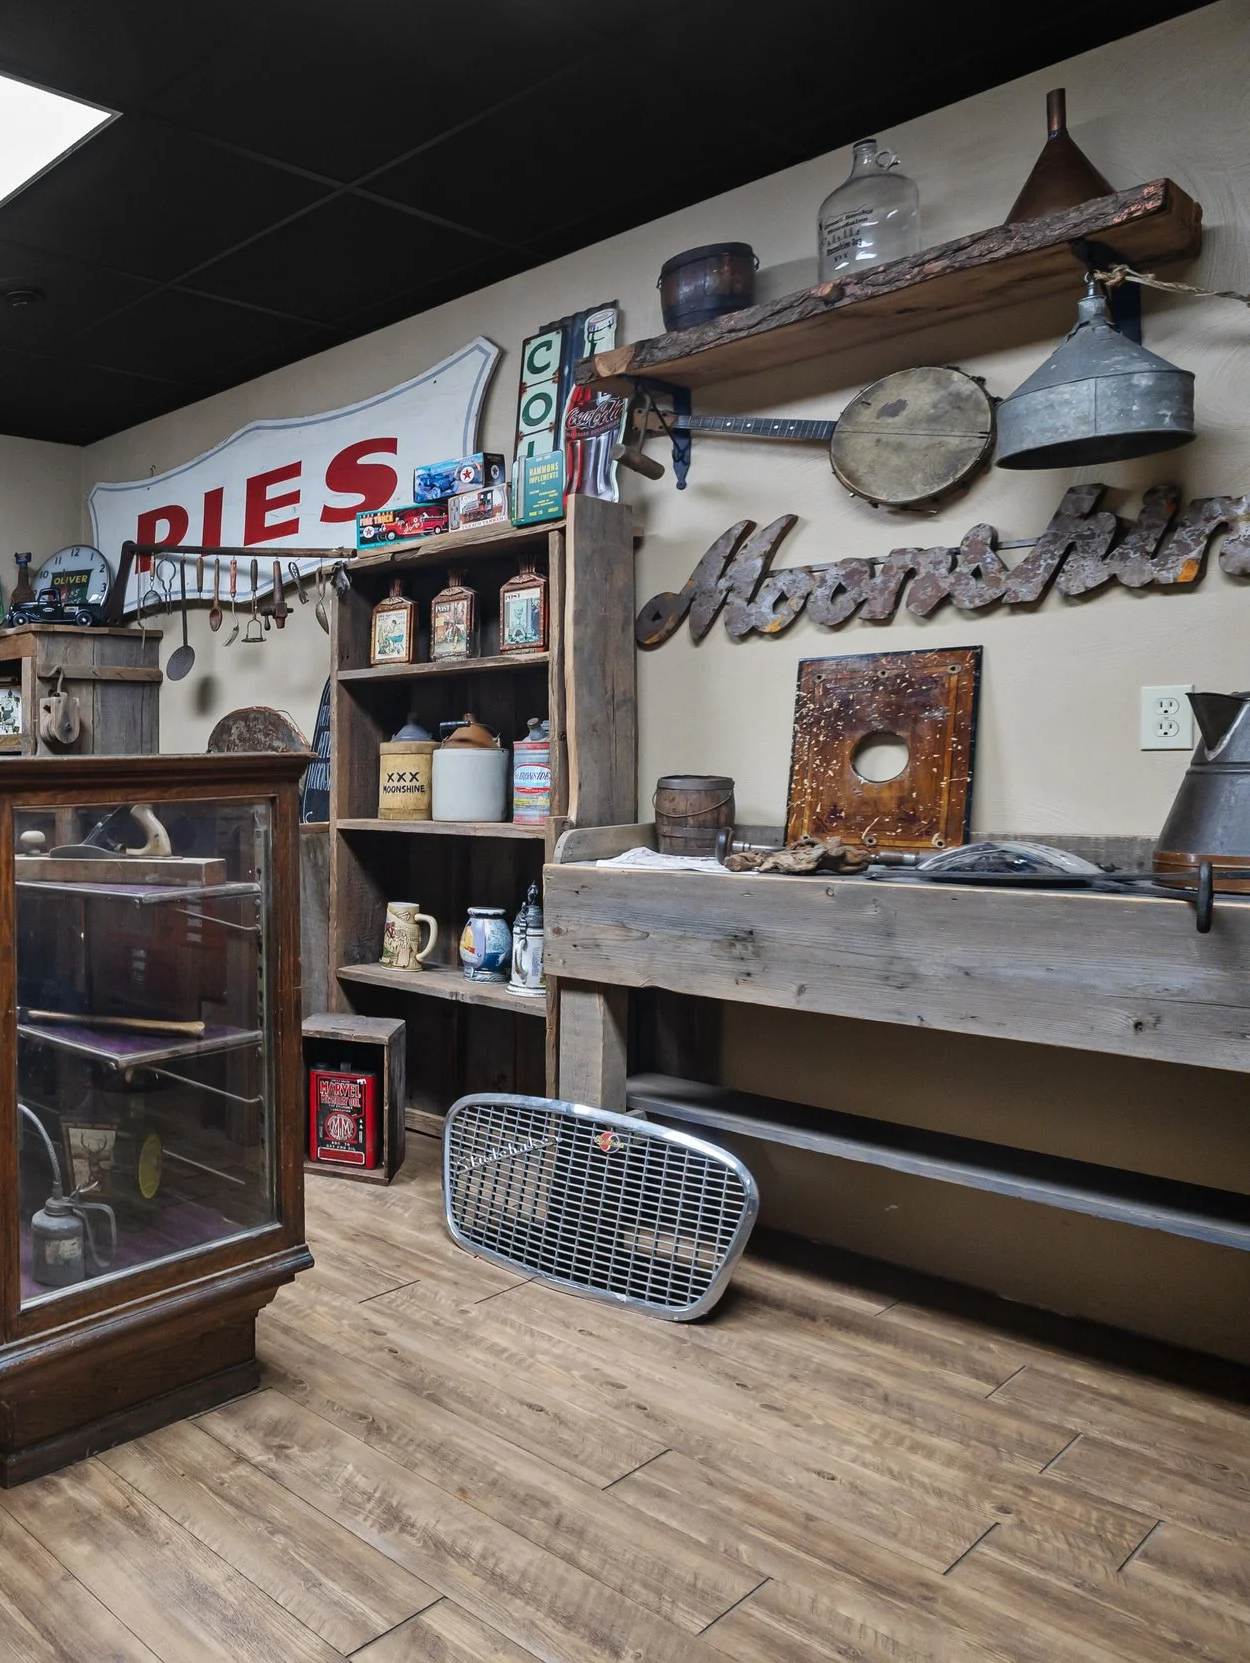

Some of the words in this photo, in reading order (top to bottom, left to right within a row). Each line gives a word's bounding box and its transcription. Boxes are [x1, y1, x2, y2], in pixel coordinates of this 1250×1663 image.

[134, 437, 398, 575] PIES
[70, 548, 80, 557] 12
[90, 552, 94, 561] 1
[54, 556, 62, 565] 11
[99, 564, 106, 573] 2
[39, 571, 49, 579] 10
[53, 574, 88, 586] OLIVER
[100, 582, 107, 593] 3
[435, 604, 451, 613] POST
[386, 772, 420, 783] XXX
[382, 785, 426, 794] MOONSHINE
[319, 1080, 362, 1099] MARVEL
[349, 1097, 362, 1108] OIL
[456, 1136, 562, 1173] Studebaker
